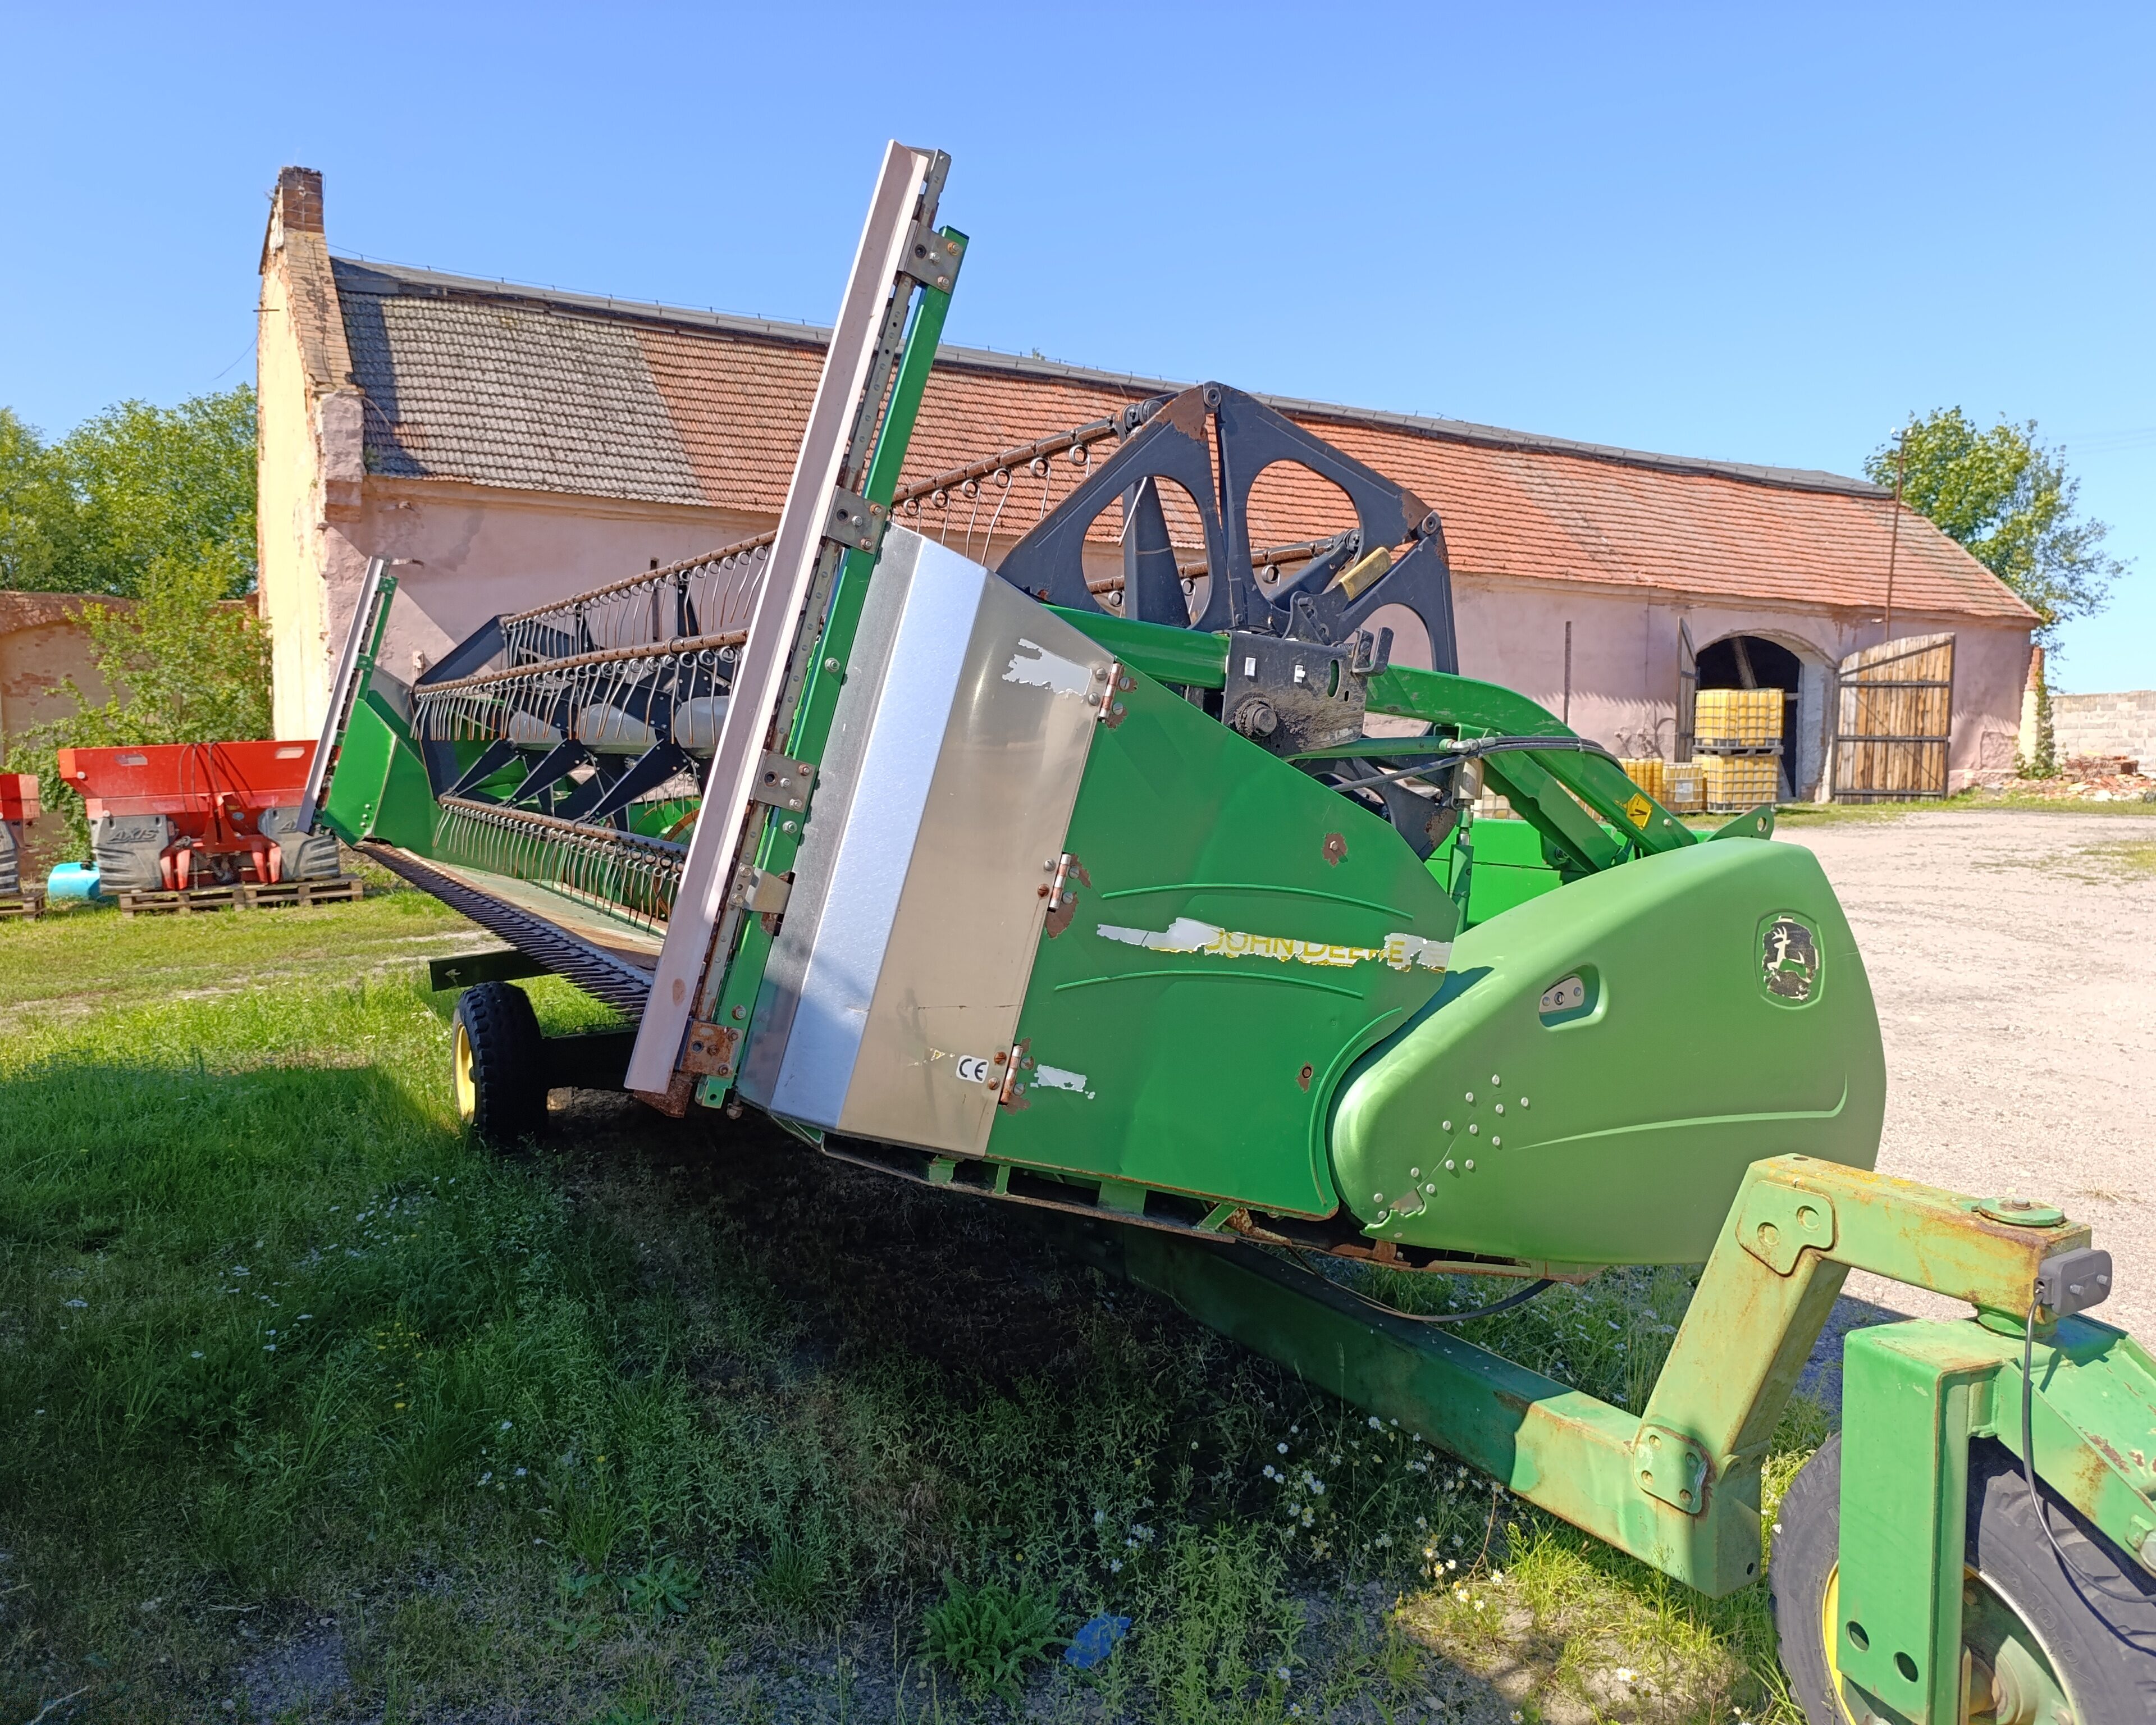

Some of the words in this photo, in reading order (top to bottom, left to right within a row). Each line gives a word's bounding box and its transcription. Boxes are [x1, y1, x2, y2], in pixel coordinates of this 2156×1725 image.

[107, 828, 159, 842] AXIS
[1205, 930, 1294, 956] JOHN
[959, 1058, 986, 1081] CE
